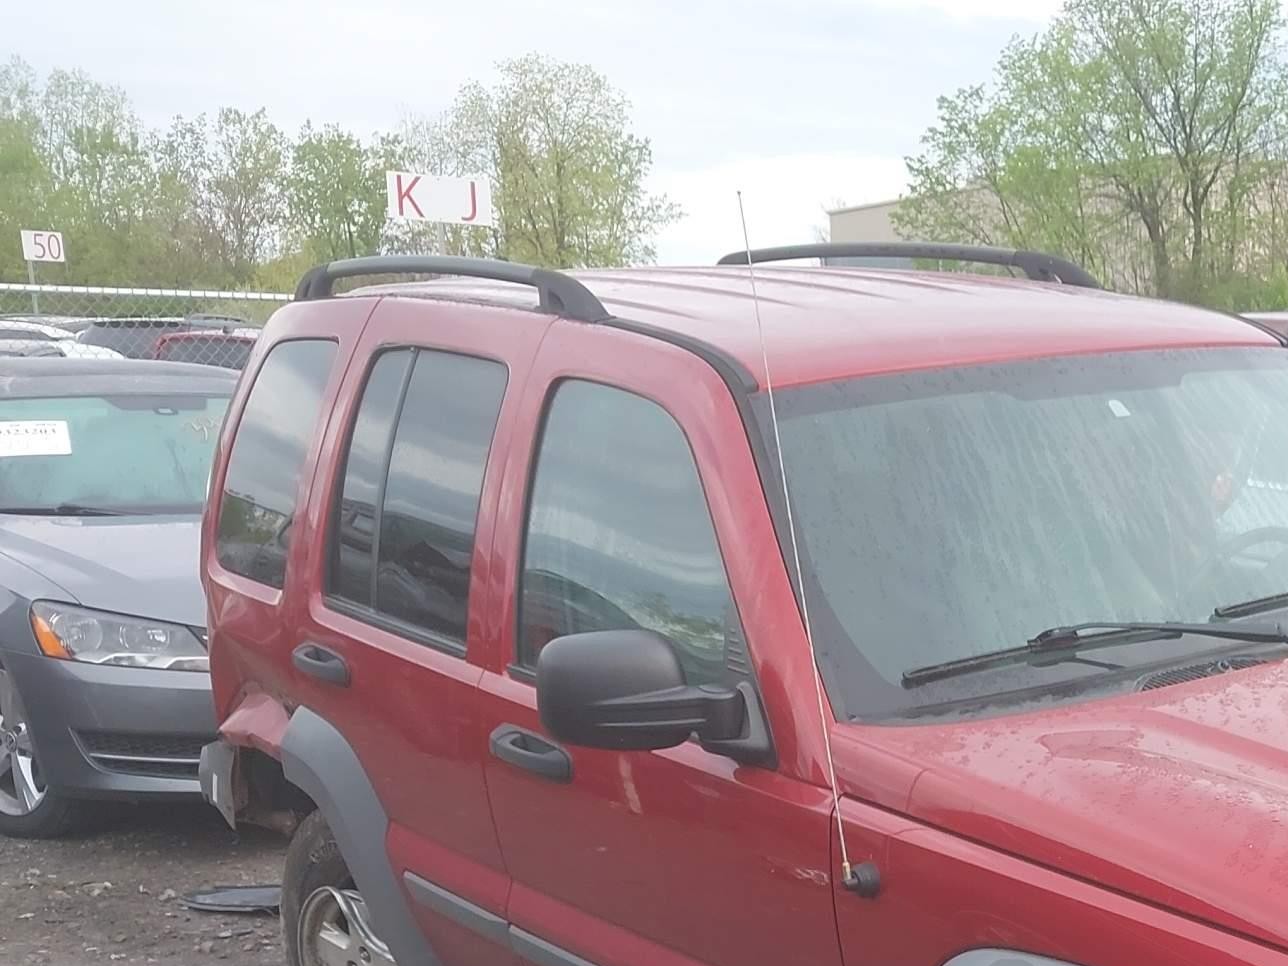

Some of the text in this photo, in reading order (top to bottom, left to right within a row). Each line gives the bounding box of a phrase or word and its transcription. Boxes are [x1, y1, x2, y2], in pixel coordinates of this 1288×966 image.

[396, 174, 477, 221] K J
[33, 233, 62, 260] 50
